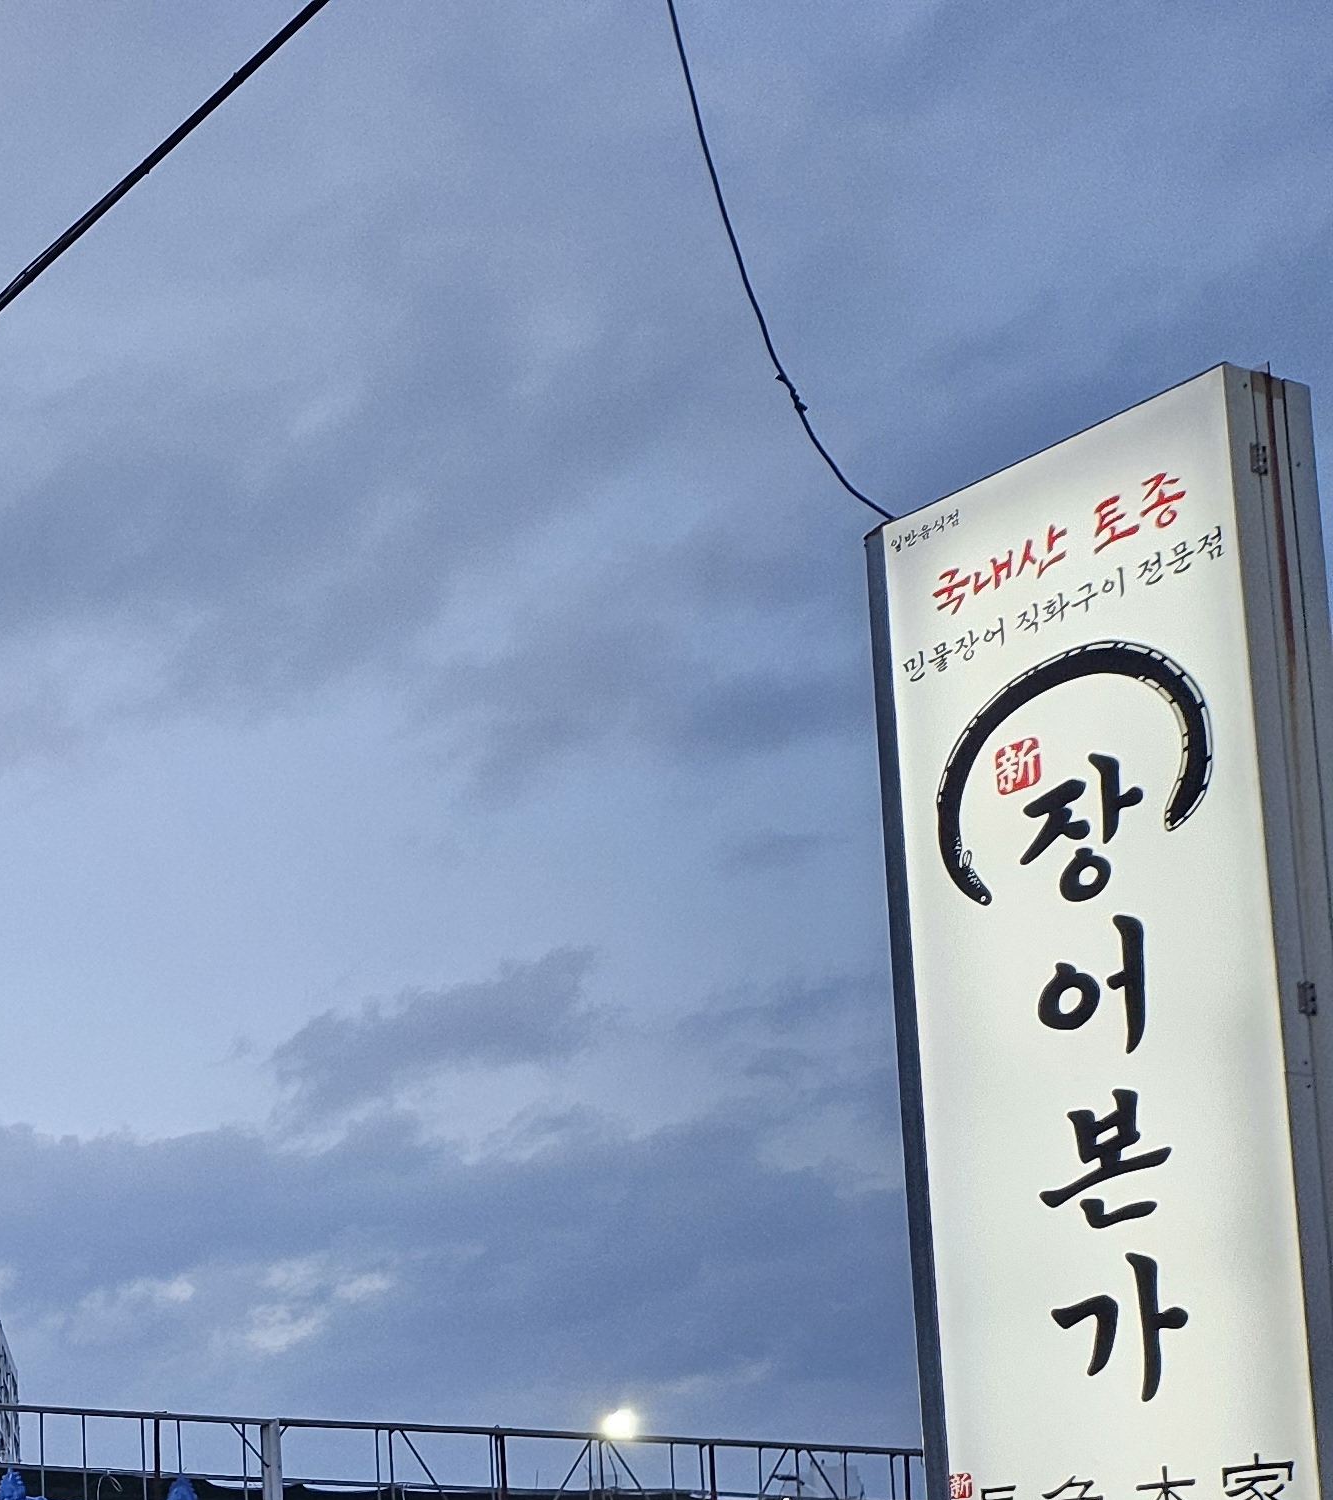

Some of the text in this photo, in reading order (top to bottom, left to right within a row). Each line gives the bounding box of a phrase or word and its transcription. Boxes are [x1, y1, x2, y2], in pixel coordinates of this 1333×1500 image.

[890, 508, 961, 552] 일반음식점
[931, 472, 1186, 616] 국내산 토종
[902, 525, 1225, 684] 민물장어 직화구이 전문점
[994, 736, 1041, 796] 新
[1020, 753, 1188, 1402] 장어본가
